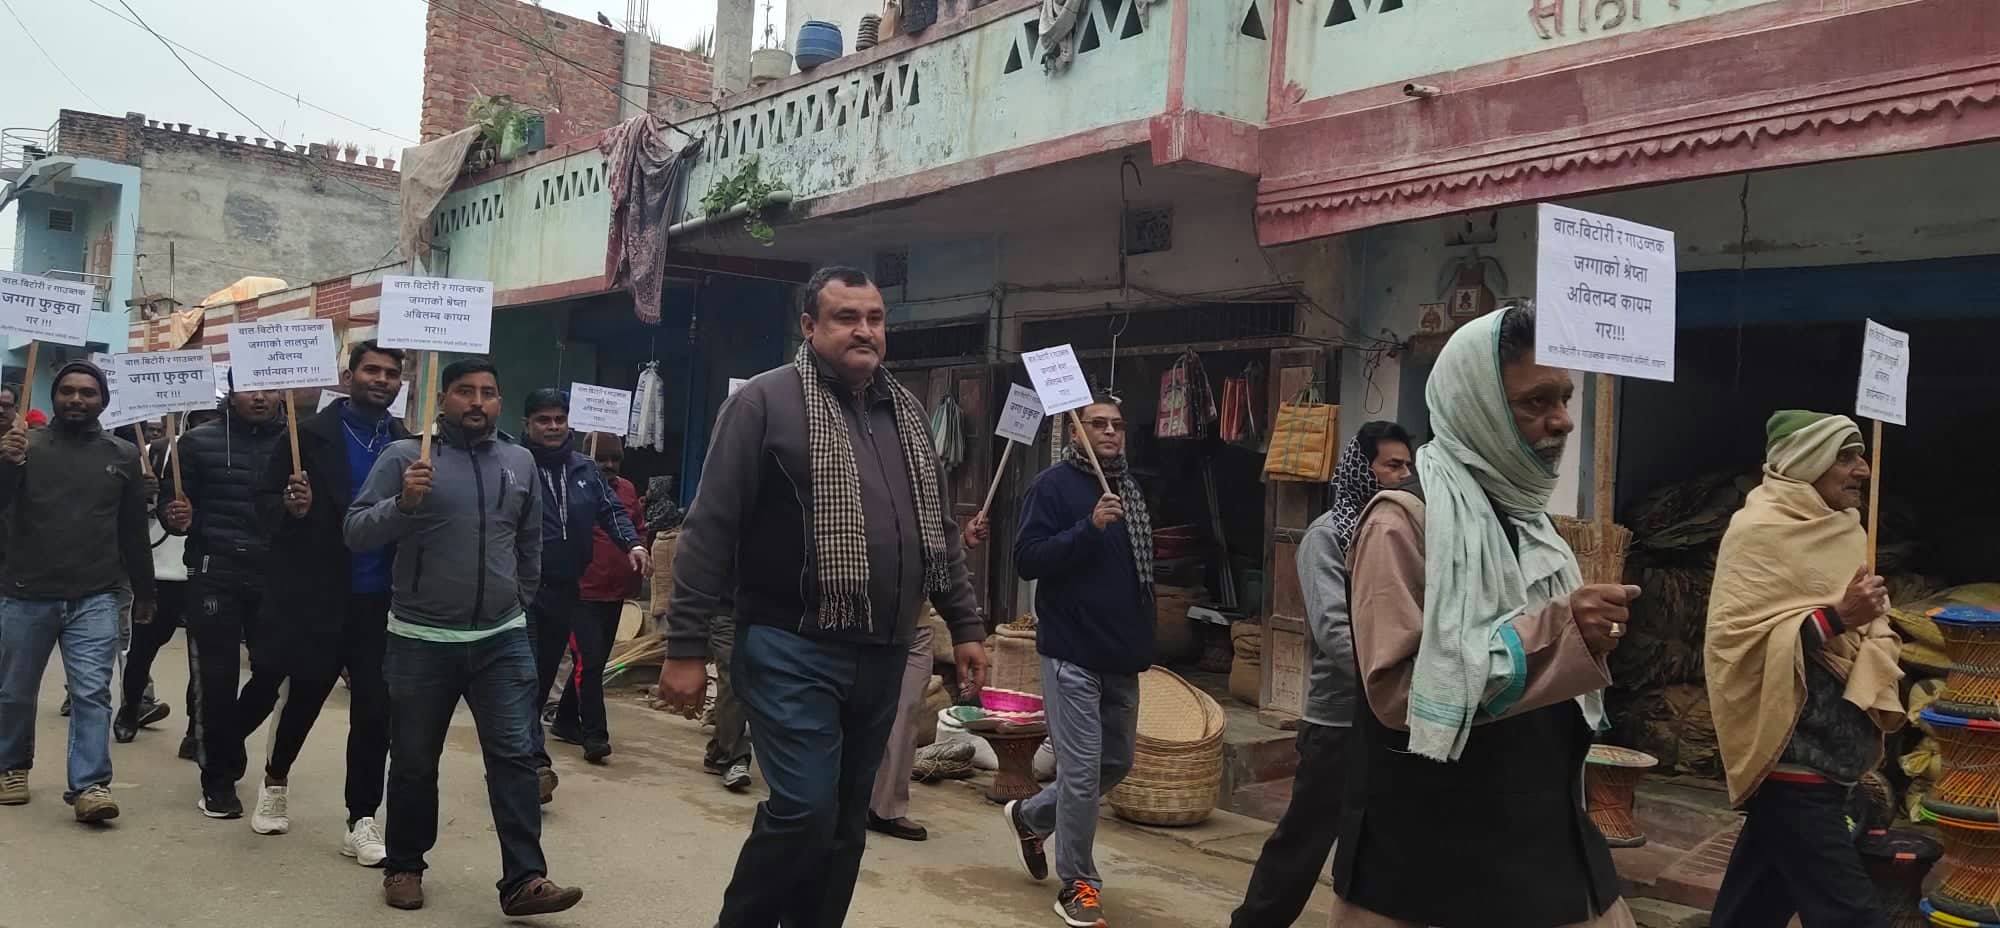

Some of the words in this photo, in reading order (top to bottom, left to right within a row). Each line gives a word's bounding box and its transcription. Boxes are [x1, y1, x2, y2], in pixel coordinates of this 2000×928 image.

[1574, 255, 1620, 278] जग्गाको
[1, 291, 36, 308] जग्गा
[39, 297, 82, 315] फुकुवा
[408, 295, 443, 306] जग्गाको
[1620, 293, 1653, 314] कायम
[25, 315, 39, 325] गर
[443, 312, 471, 322] कायम
[248, 337, 282, 349] जग्गाको
[284, 335, 319, 349] लालपुर्जा
[296, 365, 309, 376] गर
[127, 371, 161, 385] जग्गा
[163, 369, 204, 386] फुकुवा
[156, 390, 169, 401] गर
